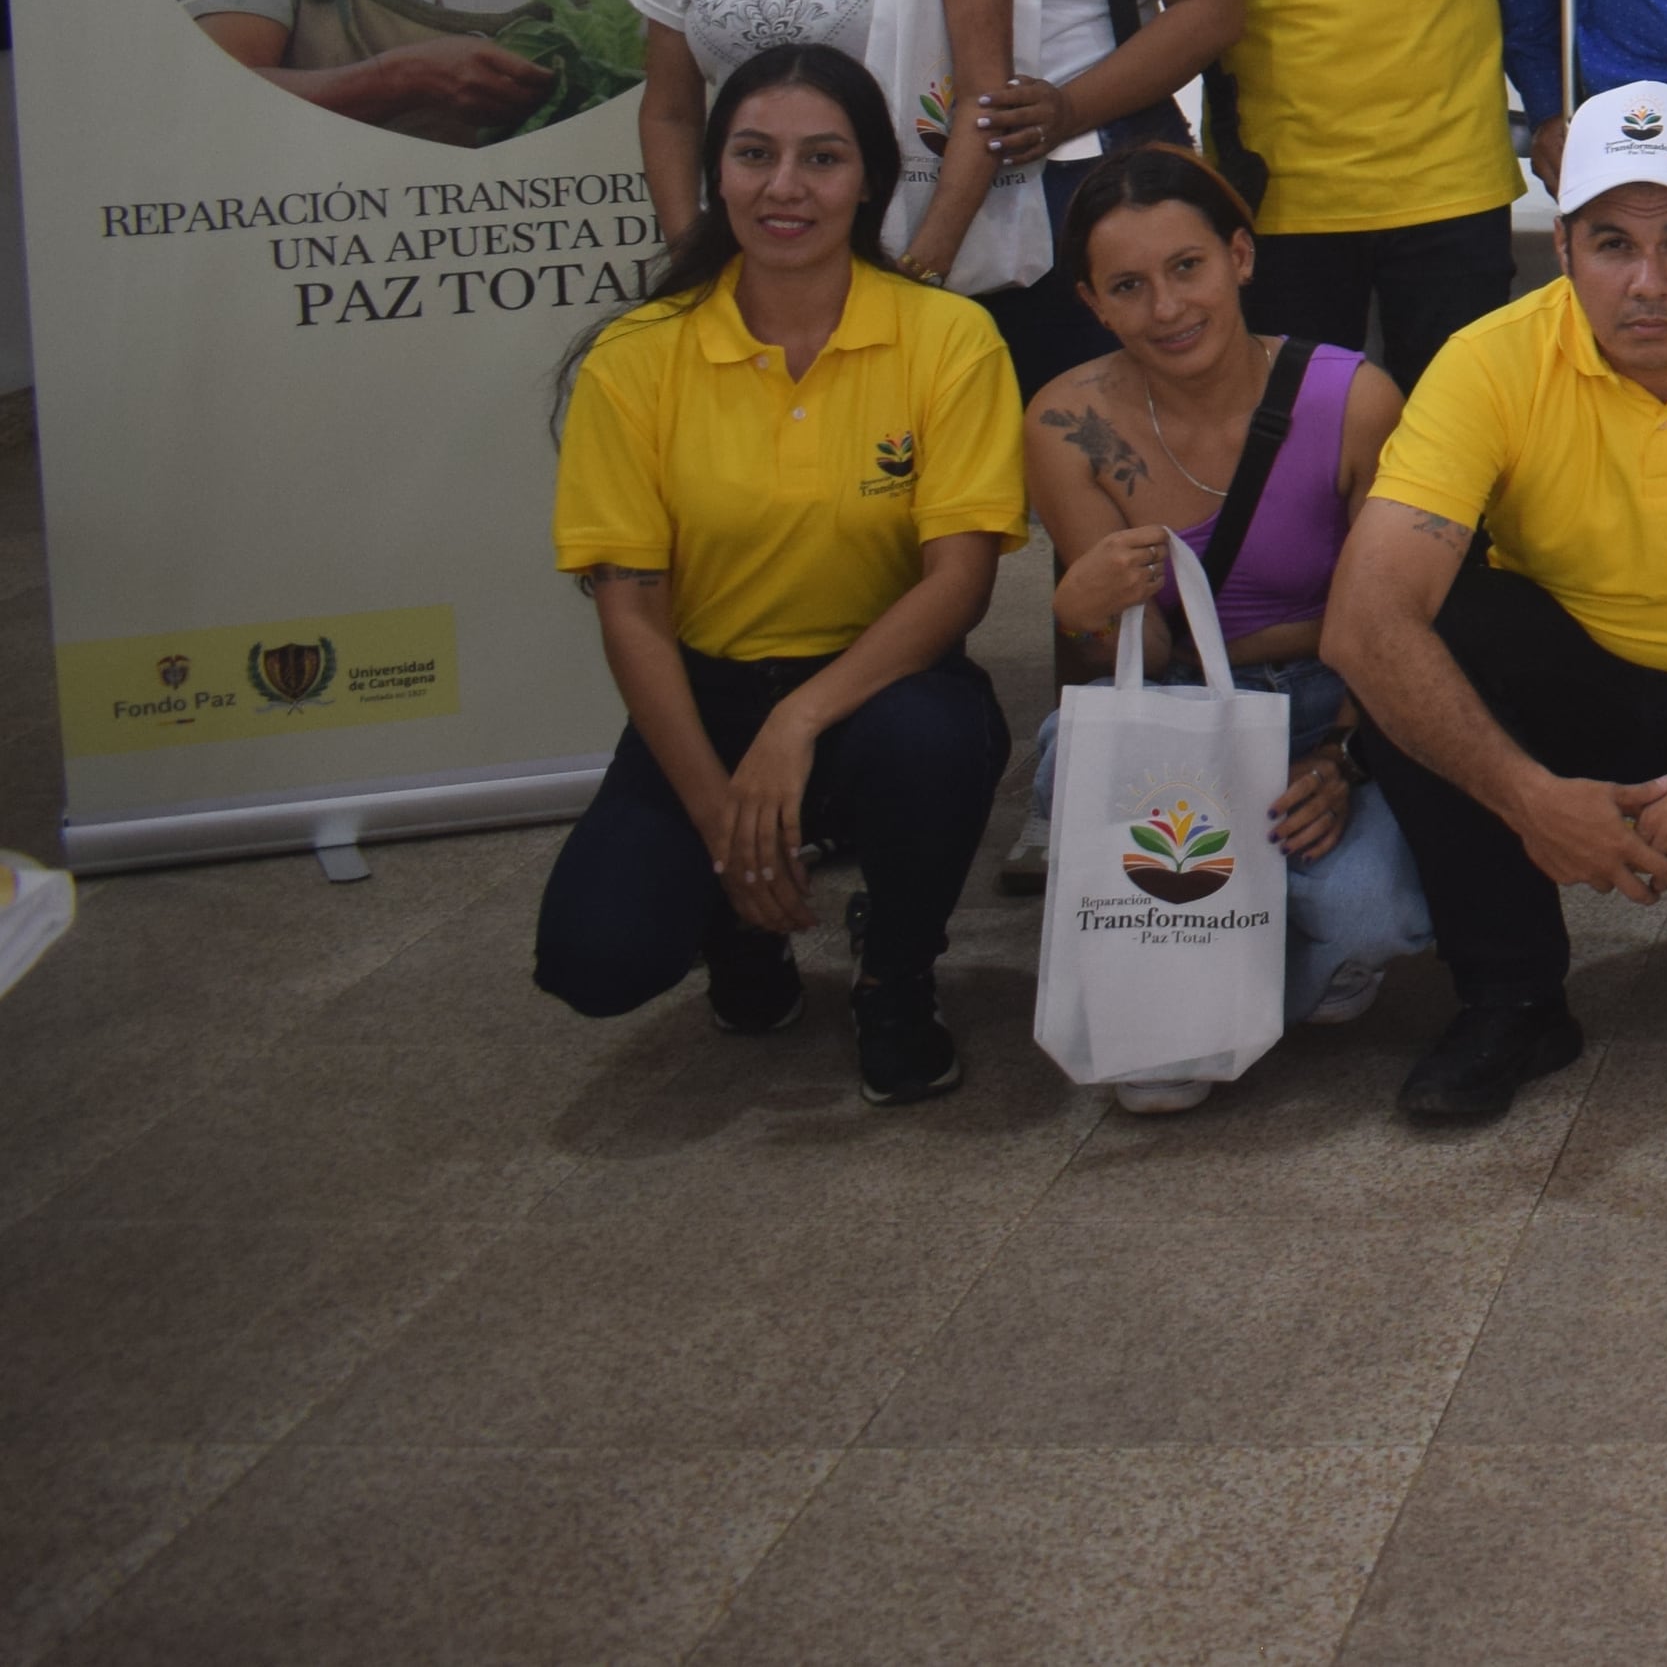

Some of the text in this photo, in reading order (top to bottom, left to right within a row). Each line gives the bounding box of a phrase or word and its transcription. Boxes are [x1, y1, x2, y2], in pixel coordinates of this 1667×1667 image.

[100, 181, 389, 237] REPARACIÓN
[270, 233, 375, 270] UNA
[385, 218, 603, 265] APUESTA
[295, 274, 424, 327] PAZ
[349, 659, 435, 679] Universidad
[349, 673, 436, 692] de Cartagena
[113, 691, 237, 719] Fondo Paz
[1081, 894, 1152, 910] Reparación
[1076, 907, 1270, 932] Transformadora
